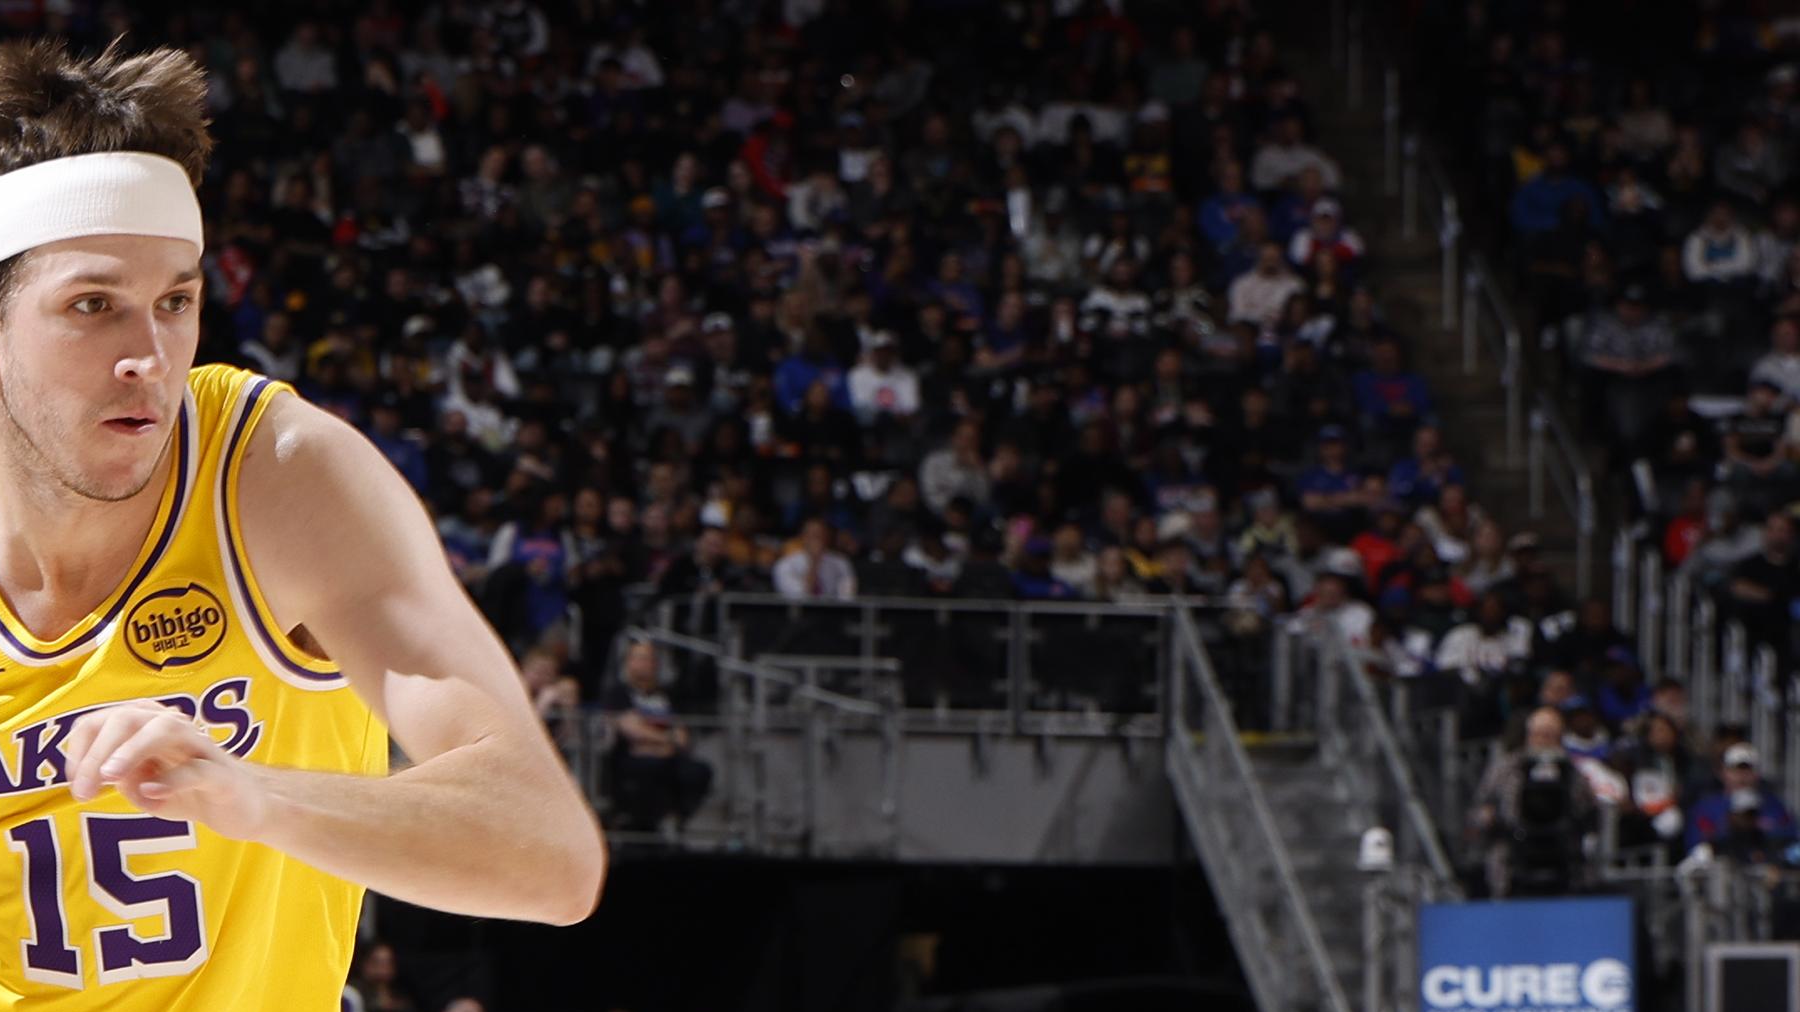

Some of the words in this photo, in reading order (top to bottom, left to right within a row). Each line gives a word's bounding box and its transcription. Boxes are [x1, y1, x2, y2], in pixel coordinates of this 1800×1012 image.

[131, 605, 220, 644] bibigo
[152, 633, 191, 653] 비비고
[3, 811, 208, 990] 15
[1422, 963, 1581, 1009] CURE
